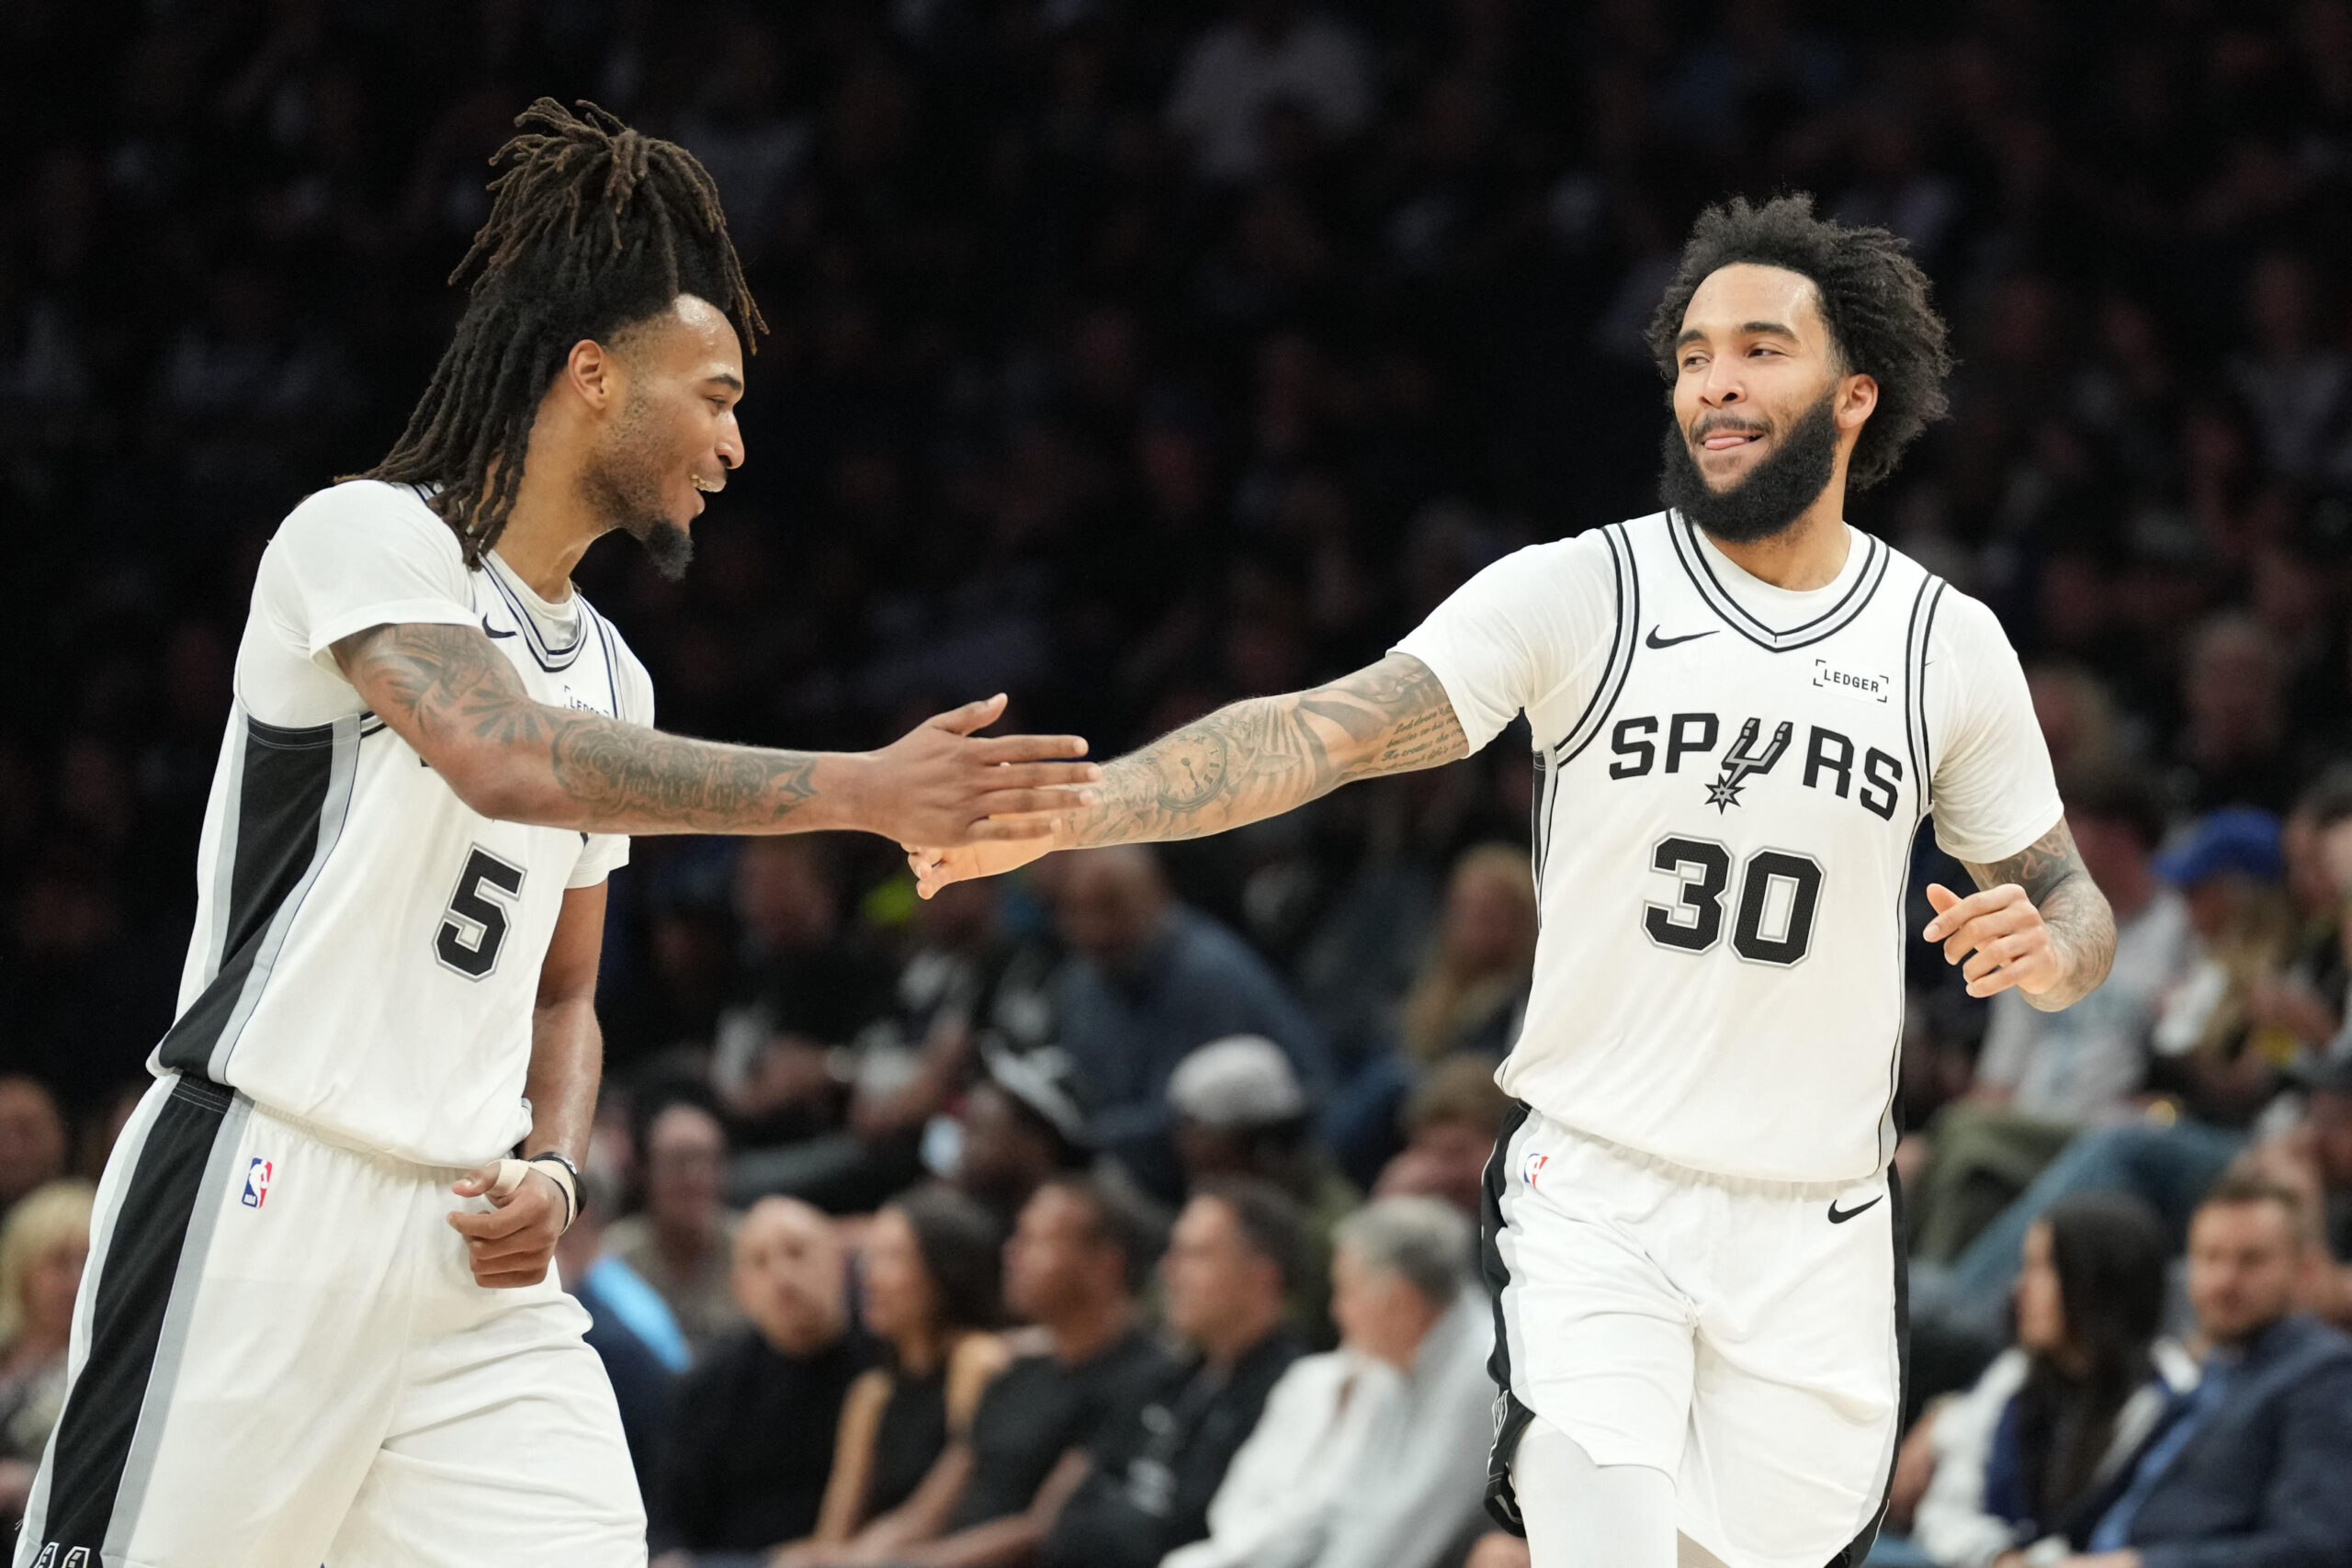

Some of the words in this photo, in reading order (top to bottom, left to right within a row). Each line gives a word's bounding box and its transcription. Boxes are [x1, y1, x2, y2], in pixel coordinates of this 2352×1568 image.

[570, 695, 600, 715] LED
[1824, 669, 1879, 693] LEDGER
[1609, 712, 1904, 822] SPURS
[431, 841, 527, 983] 5
[1640, 831, 1827, 970] 30
